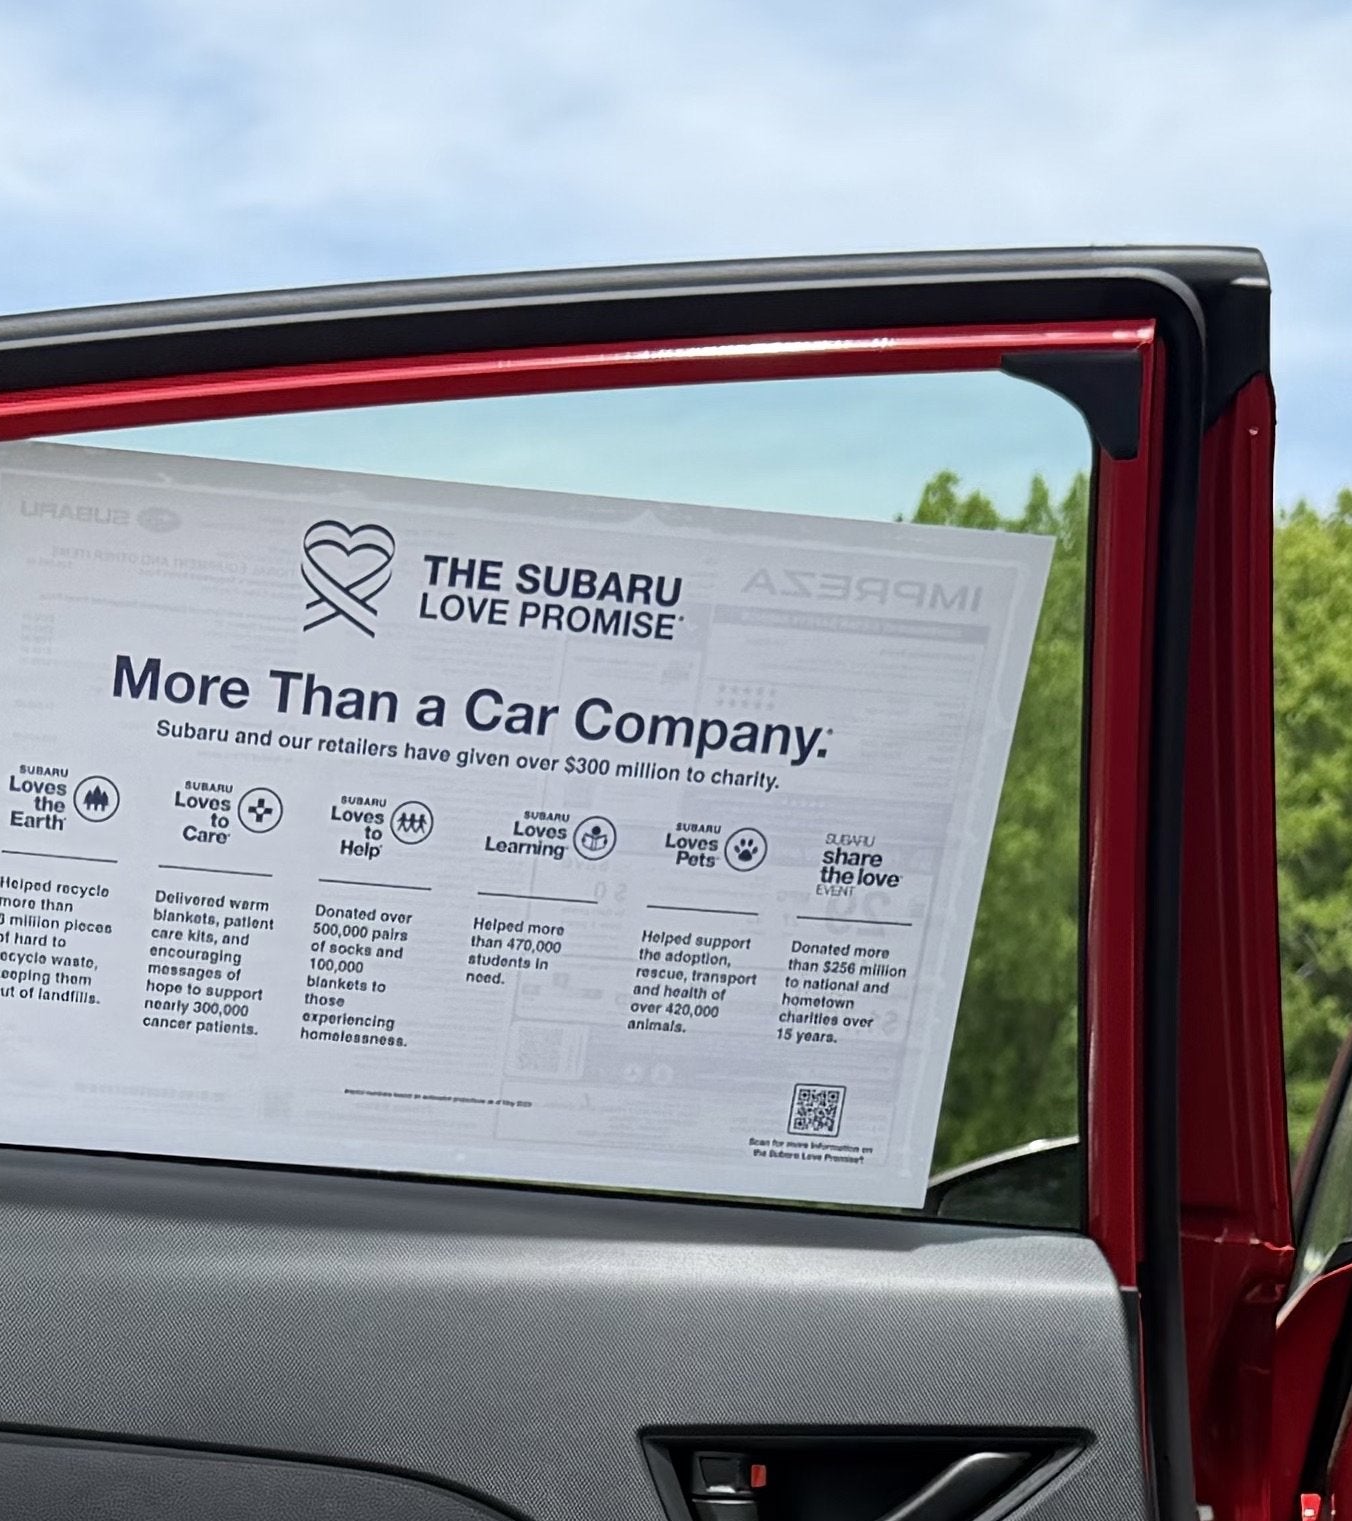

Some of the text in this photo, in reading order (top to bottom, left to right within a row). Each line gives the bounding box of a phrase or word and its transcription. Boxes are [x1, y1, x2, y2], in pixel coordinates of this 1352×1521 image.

[423, 554, 683, 608] THE SUBARU
[419, 591, 510, 627] LOVE
[518, 600, 677, 641] PROMISE
[112, 654, 829, 767] More Than a Car Company.
[156, 719, 780, 793] Subaru and our retailers have given over $300 million to charity.
[19, 764, 69, 778] SUBARU
[8, 774, 68, 797] Loves
[184, 780, 234, 794] SUBARU
[33, 795, 66, 814] the
[174, 790, 232, 812] Loves
[340, 795, 387, 808] SUBARU
[9, 809, 67, 832] Earth
[210, 812, 230, 829] to
[330, 805, 385, 826] Loves
[523, 810, 571, 823] SUBARU
[182, 824, 231, 845] Care
[364, 825, 383, 841] to
[512, 820, 568, 841] Loves
[675, 822, 722, 835] SUBARU
[339, 839, 383, 861] Help
[484, 835, 569, 861] Learning
[664, 832, 719, 852] Loves
[825, 832, 876, 848] SUBARU
[675, 849, 720, 869] Pets
[821, 846, 883, 868] share
[820, 865, 904, 888] the love
[0, 875, 110, 899] Helped recycle
[815, 883, 855, 897] EVENT
[40, 898, 74, 913] than
[155, 889, 270, 912] Delivered warm
[153, 907, 274, 931] blankets, patient
[315, 903, 413, 925] Donated over
[9, 914, 60, 930] million
[63, 919, 113, 935] pieces
[312, 921, 408, 943] 500,000 pairs
[473, 916, 565, 937] Helped more
[14, 931, 48, 947] hard
[52, 935, 67, 948] to
[150, 928, 250, 946] care kits, and
[471, 934, 562, 954] than 470,000
[641, 929, 752, 952] Helped support
[149, 945, 242, 967] encouraging
[310, 940, 404, 960] of socks and
[639, 947, 732, 969] the adoption,
[791, 940, 890, 960] Donated more
[51, 955, 98, 972] waste,
[310, 957, 364, 974] 100,000
[467, 953, 549, 971] students in
[788, 958, 907, 979] than $256 million
[55, 971, 92, 987] them
[147, 963, 242, 982] messages of
[465, 972, 505, 985] need.
[635, 967, 758, 987] rescue, transport
[145, 978, 263, 1002] hope to support
[306, 974, 387, 993] blankets to
[632, 983, 727, 1001] and health of
[785, 975, 890, 995] to national and
[19, 986, 35, 999] of
[37, 987, 101, 1005] landfills.
[304, 992, 345, 1008] those
[781, 992, 855, 1010] hometown
[144, 999, 249, 1018] nearly 300,000
[630, 1002, 720, 1019] over 420,000
[778, 1009, 875, 1028] charities over
[142, 1016, 259, 1036] cancer patients.
[301, 1012, 396, 1032] experiencing
[627, 1017, 687, 1034] animals.
[300, 1026, 408, 1047] homelessness.
[777, 1027, 838, 1045] 15 years.
